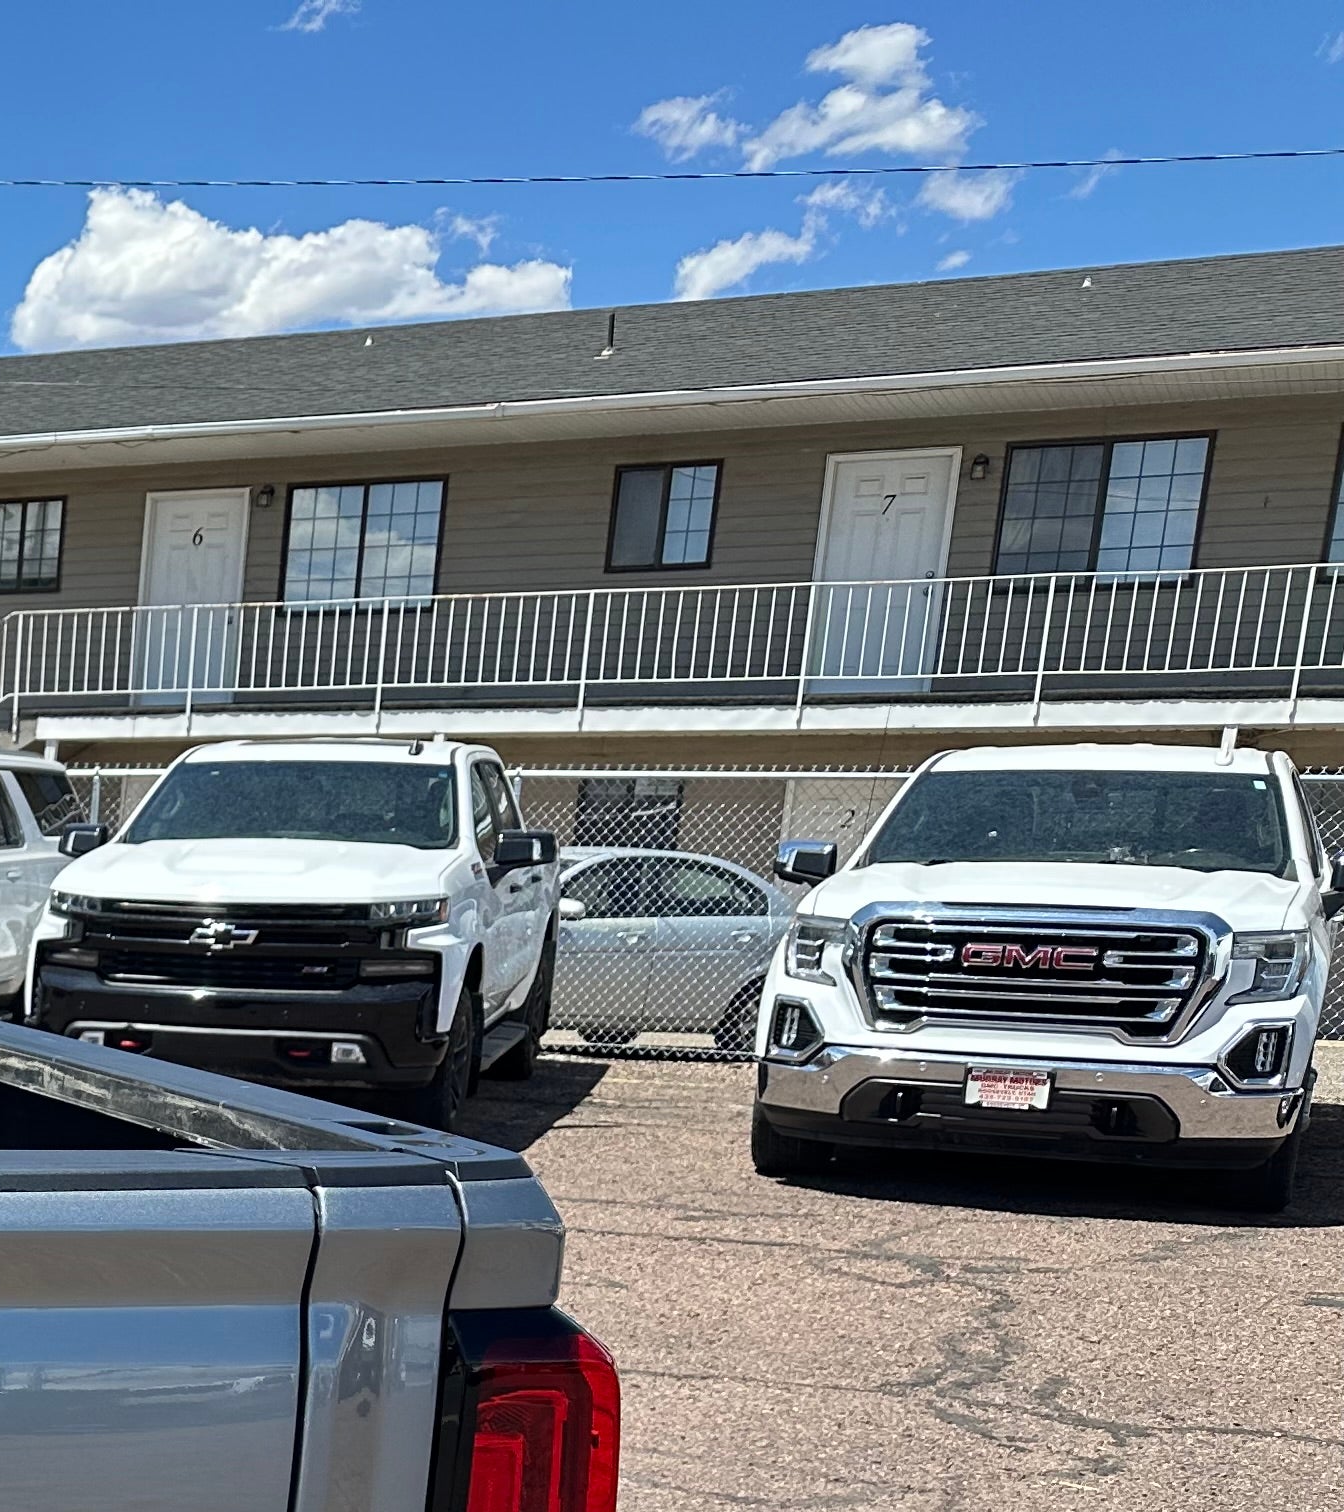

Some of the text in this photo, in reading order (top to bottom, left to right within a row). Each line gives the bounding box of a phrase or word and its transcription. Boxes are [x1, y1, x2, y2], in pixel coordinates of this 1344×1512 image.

[882, 494, 897, 515] 7
[192, 526, 204, 546] 6
[961, 942, 1099, 971] GMC
